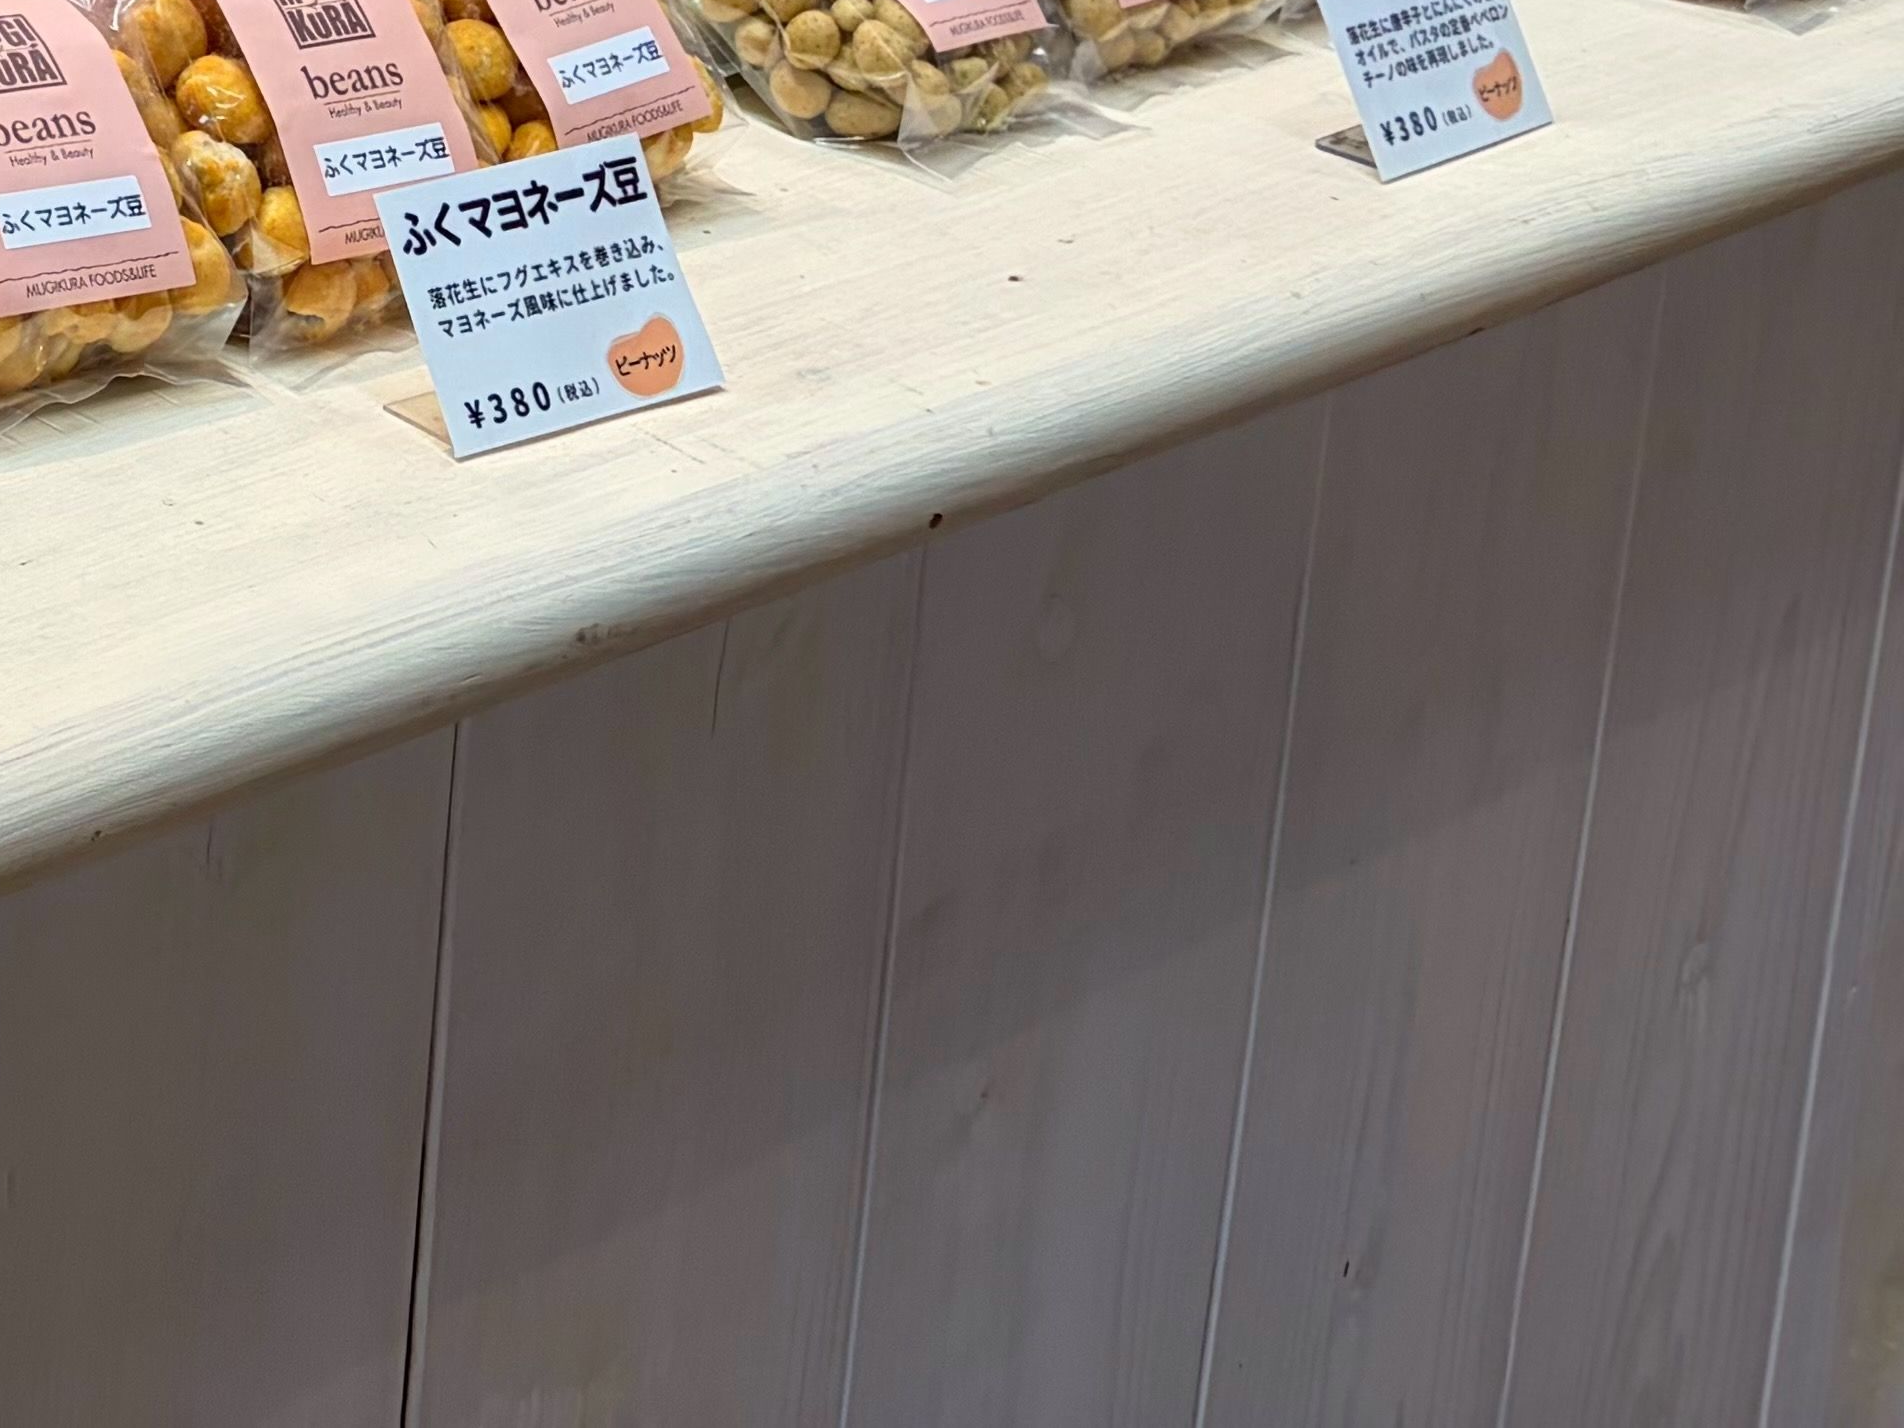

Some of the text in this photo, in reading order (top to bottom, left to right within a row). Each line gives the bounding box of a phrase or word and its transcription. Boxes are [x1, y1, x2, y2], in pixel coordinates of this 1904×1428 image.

[1355, 4, 1509, 67] オイルで、パスタの定番ペペロン
[300, 61, 404, 101] beans
[558, 39, 663, 90] ふくマヨネーズ豆
[1362, 34, 1494, 89] チーノの味を再現しました。
[1380, 106, 1438, 146] ¥380
[323, 137, 450, 180] ふくマヨネーズ豆
[1, 194, 145, 236] ふくマヨネーズ豆
[403, 156, 647, 256] ふくマヨネーズ豆
[26, 264, 157, 299] MUGIKURA FOODS&LIFE
[428, 235, 665, 310] 落花生にフグエキスを巻き込み、
[438, 267, 676, 338] マヨネーズ風味に仕上げました。
[616, 344, 677, 377] ピーナッツ
[464, 381, 551, 429] ¥380
